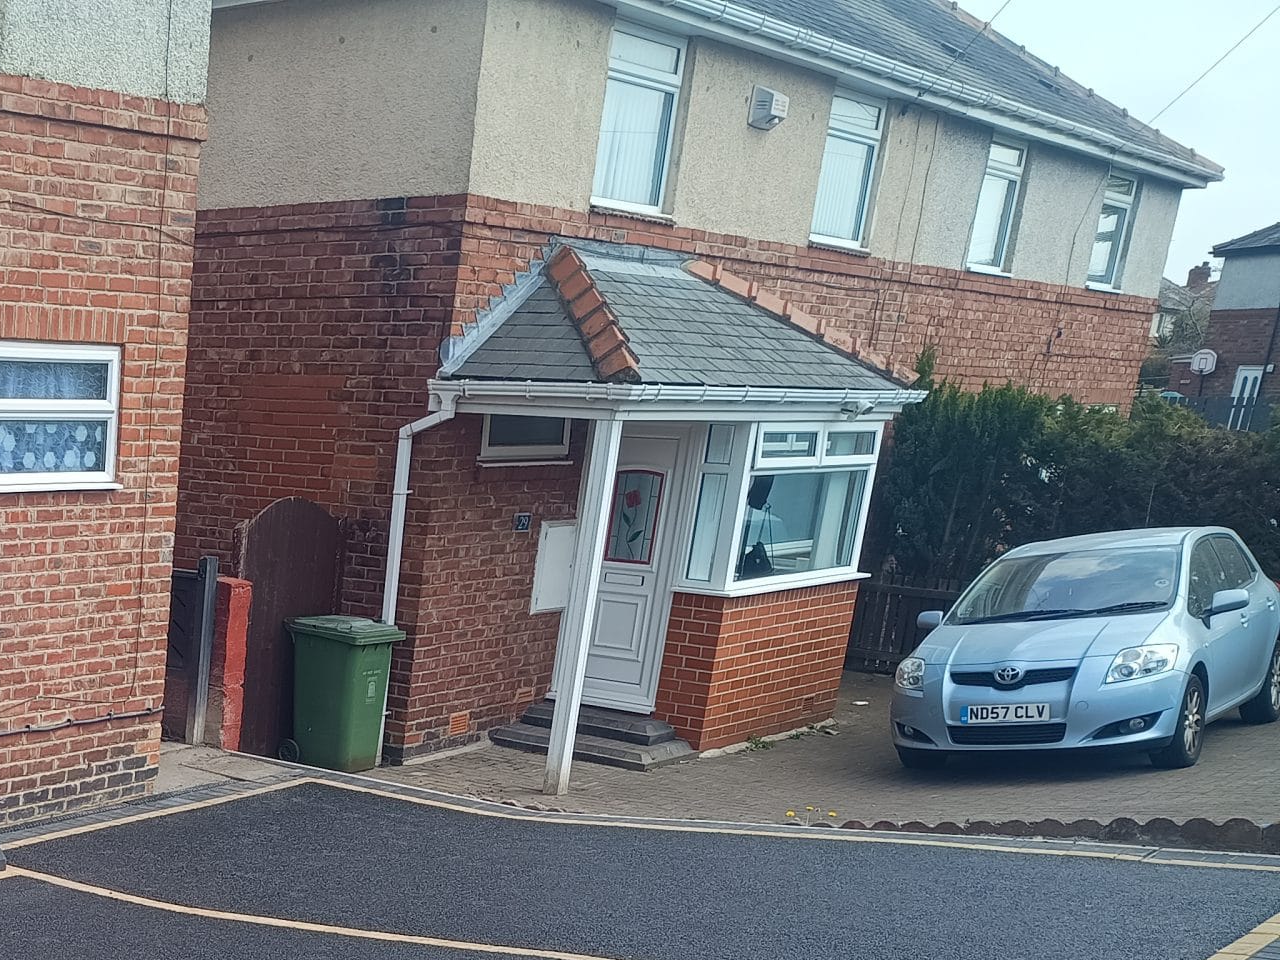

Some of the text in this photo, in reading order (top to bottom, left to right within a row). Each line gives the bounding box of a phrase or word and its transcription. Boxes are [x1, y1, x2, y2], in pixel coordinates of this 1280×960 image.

[518, 516, 529, 529] 29
[969, 705, 1045, 721] ND57 CLV
